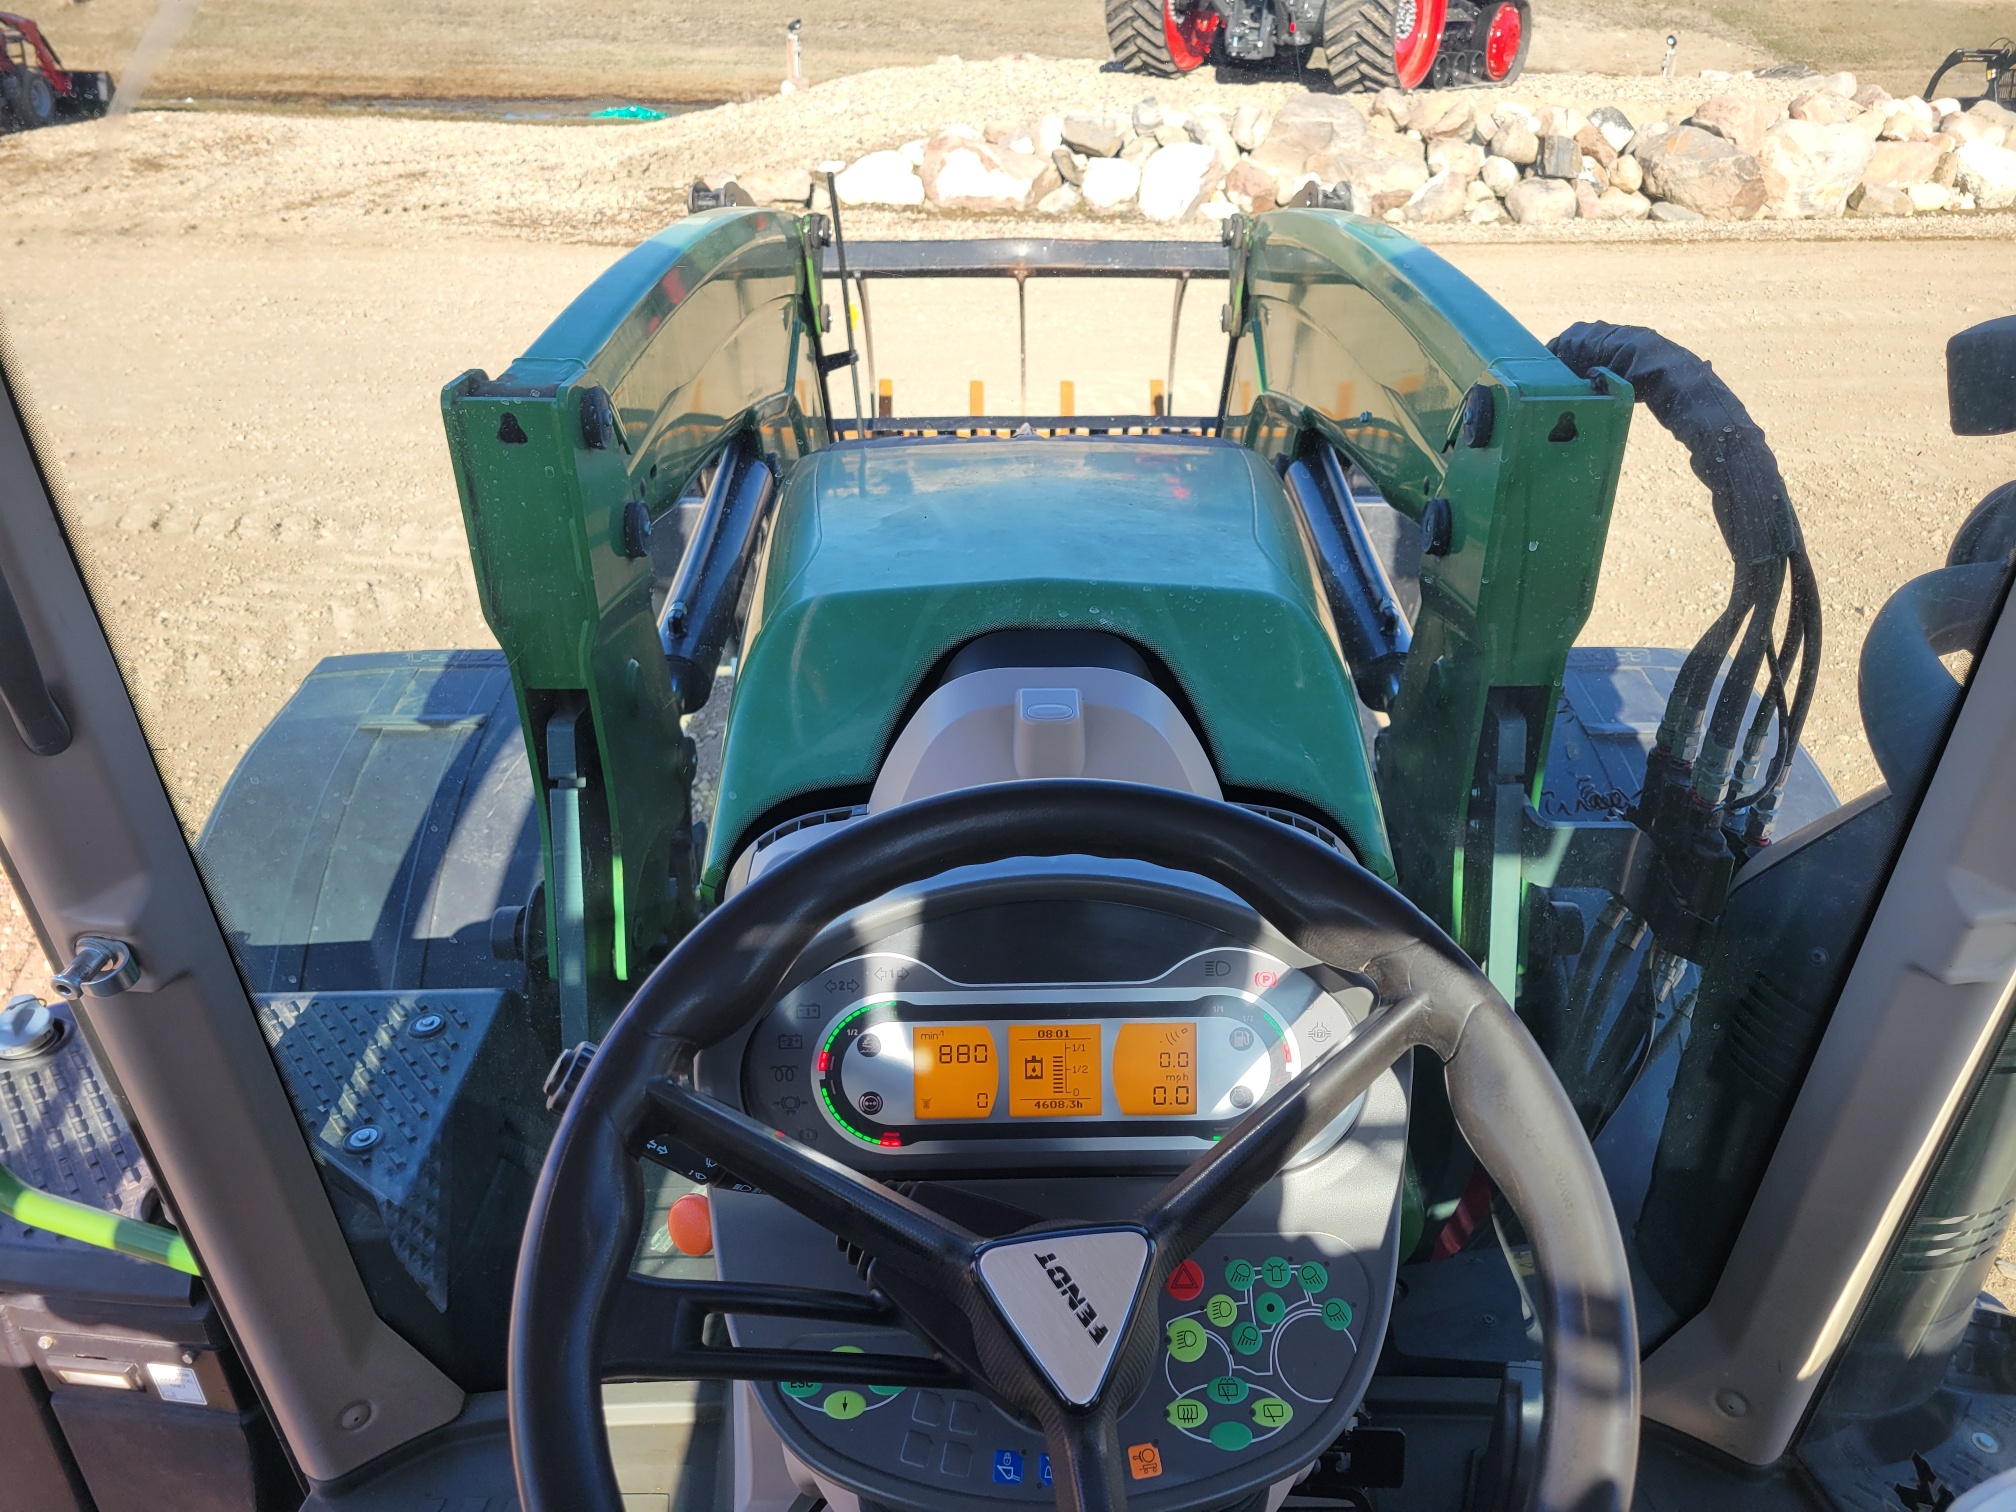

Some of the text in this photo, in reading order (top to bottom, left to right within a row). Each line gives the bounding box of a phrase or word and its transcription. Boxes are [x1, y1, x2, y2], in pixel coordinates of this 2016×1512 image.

[1038, 1029, 1070, 1038] 08:01
[939, 1044, 988, 1064] 880
[1072, 1043, 1085, 1052] 1/1
[1160, 1052, 1189, 1068] 0.0
[1072, 1065, 1088, 1074] 1/2
[1165, 1073, 1189, 1084] mph
[1072, 1087, 1080, 1097] 0
[1153, 1086, 1189, 1105] 0.0
[977, 1092, 988, 1109] 0
[1034, 1253, 1110, 1347] FENDT
